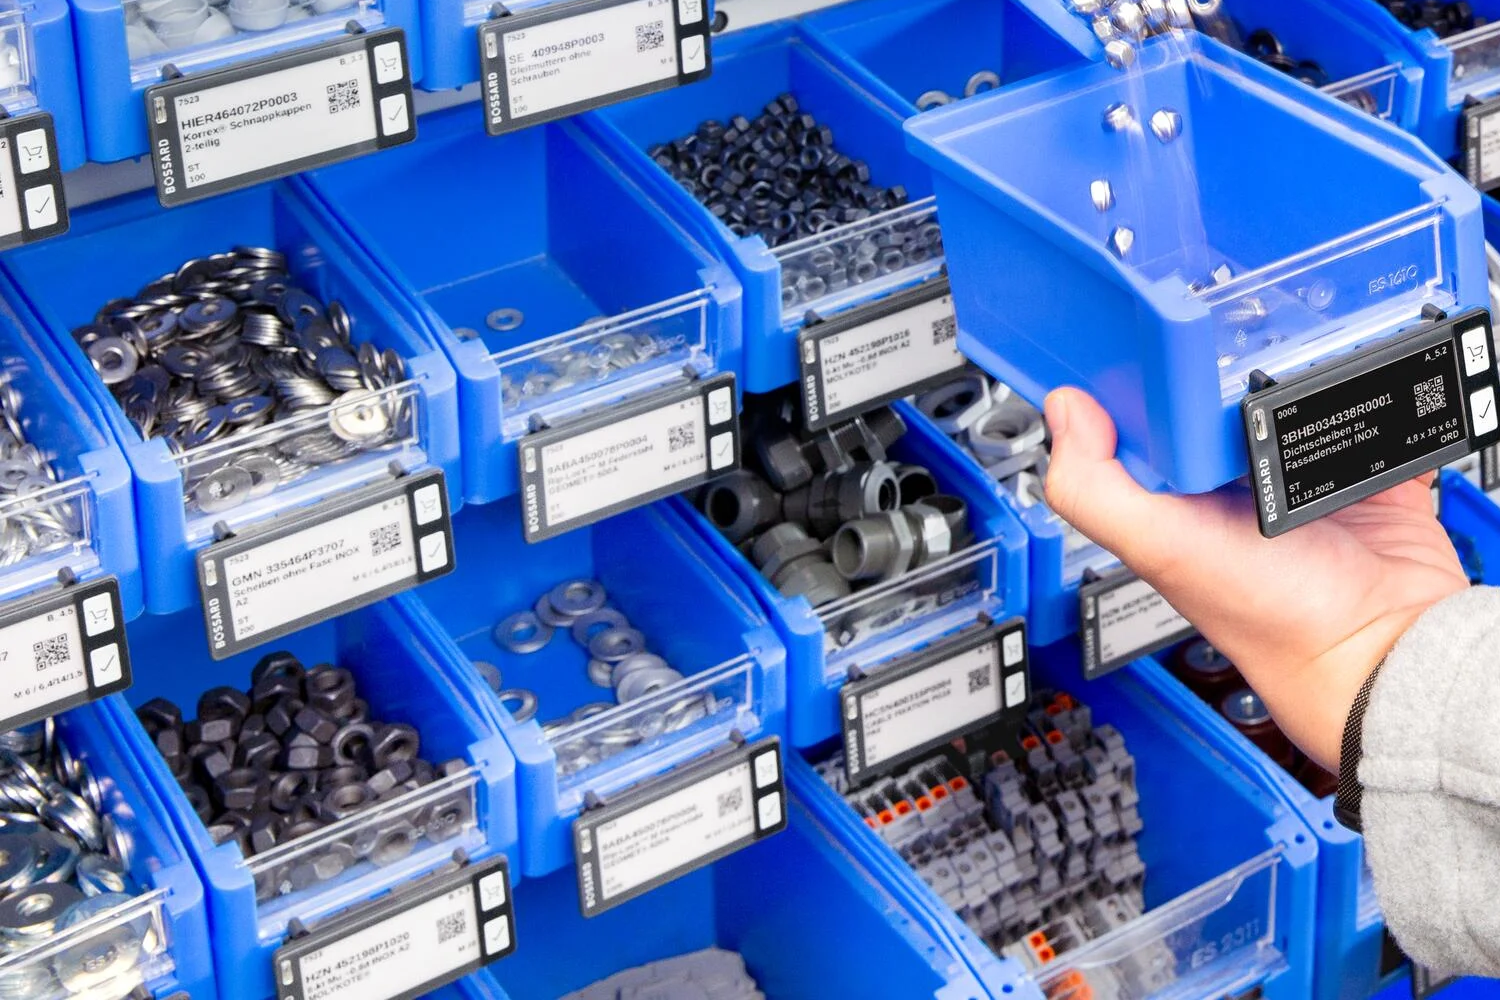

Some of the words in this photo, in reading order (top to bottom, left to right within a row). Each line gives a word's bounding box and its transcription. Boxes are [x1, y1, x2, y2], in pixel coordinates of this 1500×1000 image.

[509, 53, 524, 64] SE
[510, 55, 566, 75] Gleitmuttern
[569, 50, 591, 61] ohne
[511, 68, 560, 85] Schrauben
[178, 95, 200, 106] 7523
[488, 72, 502, 124] BOSSARD
[513, 96, 523, 104] ST
[181, 91, 298, 130] HIER464072P0003
[230, 103, 312, 130] Schnappkappen
[185, 138, 220, 153] 2-teilig
[159, 139, 175, 194] BOSSARD
[188, 163, 200, 172] ST
[190, 174, 205, 183] 100
[1425, 347, 1447, 362] A_5.2
[807, 375, 819, 422] BOSSARD
[1278, 406, 1298, 420] 0006
[1281, 393, 1393, 446] 3BHB034338R0001
[1428, 428, 1436, 437] 16
[1439, 425, 1444, 433] x
[1440, 430, 1459, 444] ORD
[1283, 425, 1351, 460] Dichtscheiben
[1355, 420, 1365, 432] zu
[1286, 440, 1352, 471] Fassadenschr
[1355, 426, 1380, 445] INOX
[1370, 460, 1385, 473] 100
[1259, 458, 1277, 523] BOSSARD
[1289, 482, 1300, 493] ST
[1291, 481, 1334, 506] 11.12.2025
[527, 484, 539, 533] BOSSARD
[232, 570, 262, 587] GMN
[234, 577, 280, 598] Scheiben
[283, 565, 306, 580] ohne
[309, 557, 331, 570] Fase
[335, 546, 360, 561] INOX
[236, 598, 248, 607] A2
[209, 598, 226, 649] BOSSARD
[238, 617, 249, 625] ST
[306, 967, 331, 983] HZN
